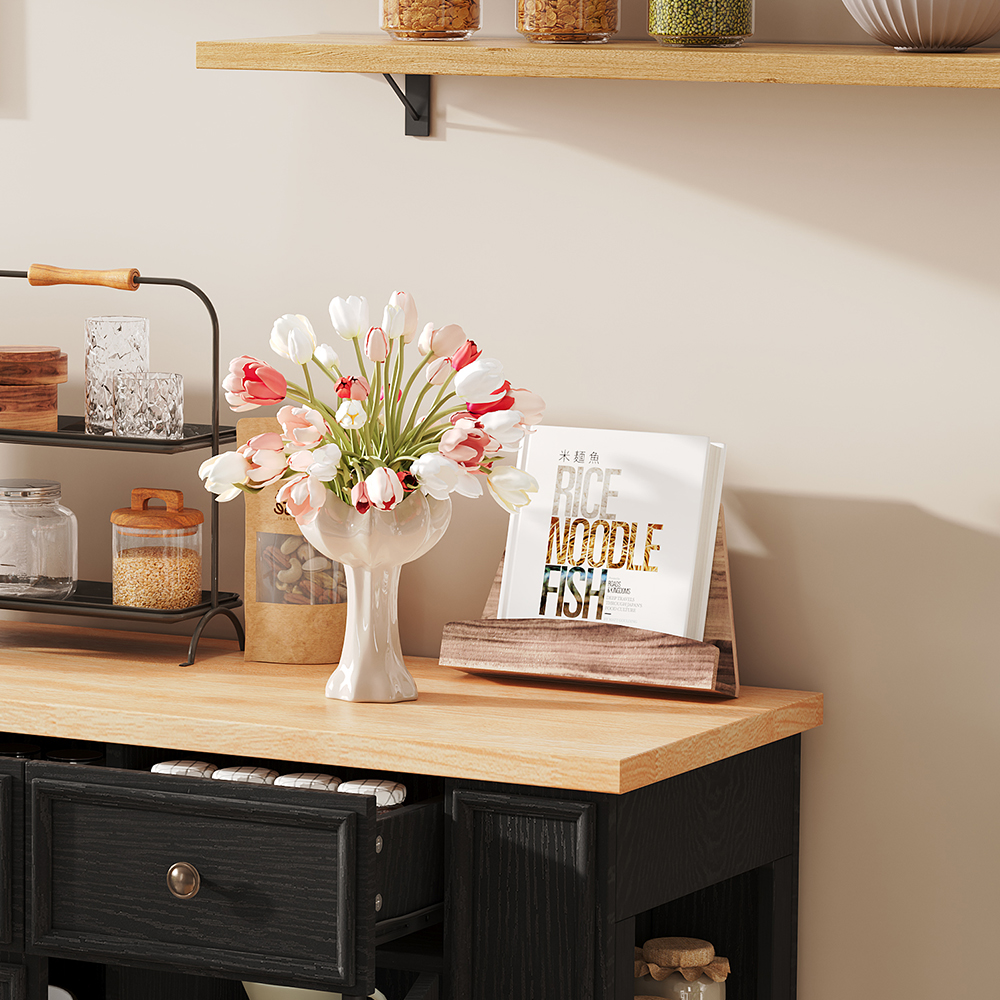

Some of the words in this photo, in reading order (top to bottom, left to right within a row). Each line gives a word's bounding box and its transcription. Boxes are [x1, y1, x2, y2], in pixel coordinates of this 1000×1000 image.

[551, 465, 622, 520] RICE
[546, 516, 664, 572] NOODLE
[539, 565, 608, 620] FISH
